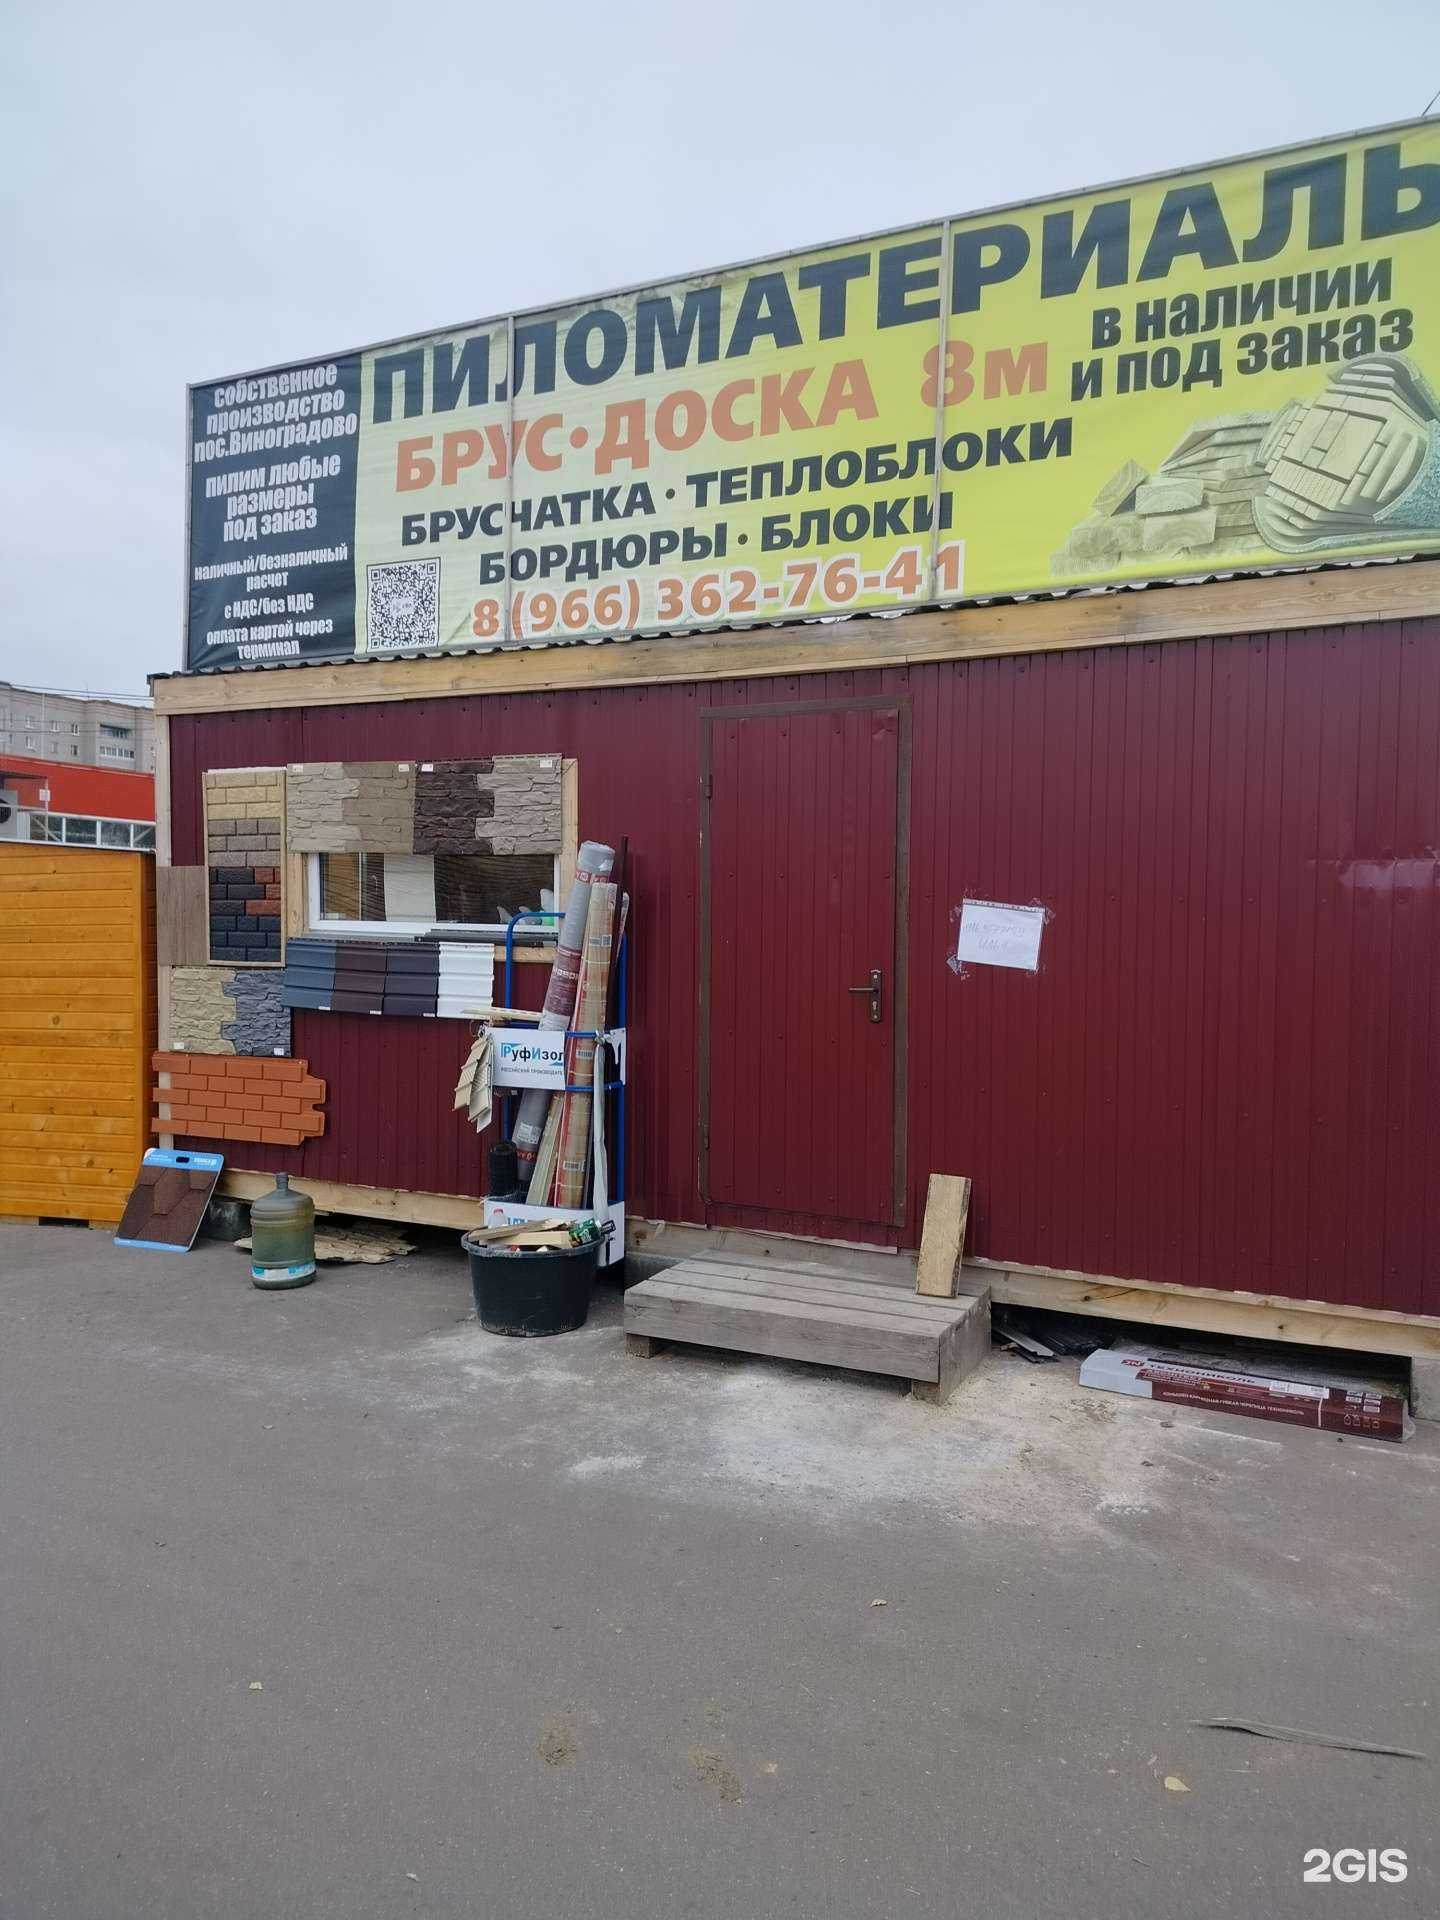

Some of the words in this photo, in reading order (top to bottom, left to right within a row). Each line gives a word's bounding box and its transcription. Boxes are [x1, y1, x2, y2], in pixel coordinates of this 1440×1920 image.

[1091, 307, 1122, 349] в
[1135, 258, 1393, 342] наличии
[1071, 359, 1103, 401] и
[1116, 345, 1222, 393] под
[1237, 308, 1414, 376] заказ
[207, 390, 345, 435] производство
[396, 413, 563, 492] БРУС
[595, 359, 879, 475] ДОСКА
[194, 413, 357, 462] пос.Виноградово
[206, 466, 265, 498] пилим
[268, 454, 341, 484] любые
[402, 481, 656, 546] БРУСЧАТКА
[686, 417, 1073, 508] ТЕПЛОБЛОКИ
[227, 483, 314, 520] размеры
[223, 517, 257, 542] под
[261, 508, 317, 535] заказ
[480, 523, 728, 585] БОРДЮРЫ
[761, 493, 954, 552] БЛОКИ
[195, 543, 348, 581] наличный/безналичный
[246, 571, 288, 592] расчет
[658, 544, 962, 620] 362-76-41
[287, 593, 314, 616] НДС
[206, 627, 248, 645] оплата
[250, 620, 293, 644] картой
[295, 618, 333, 636] через
[237, 639, 300, 660] терминал
